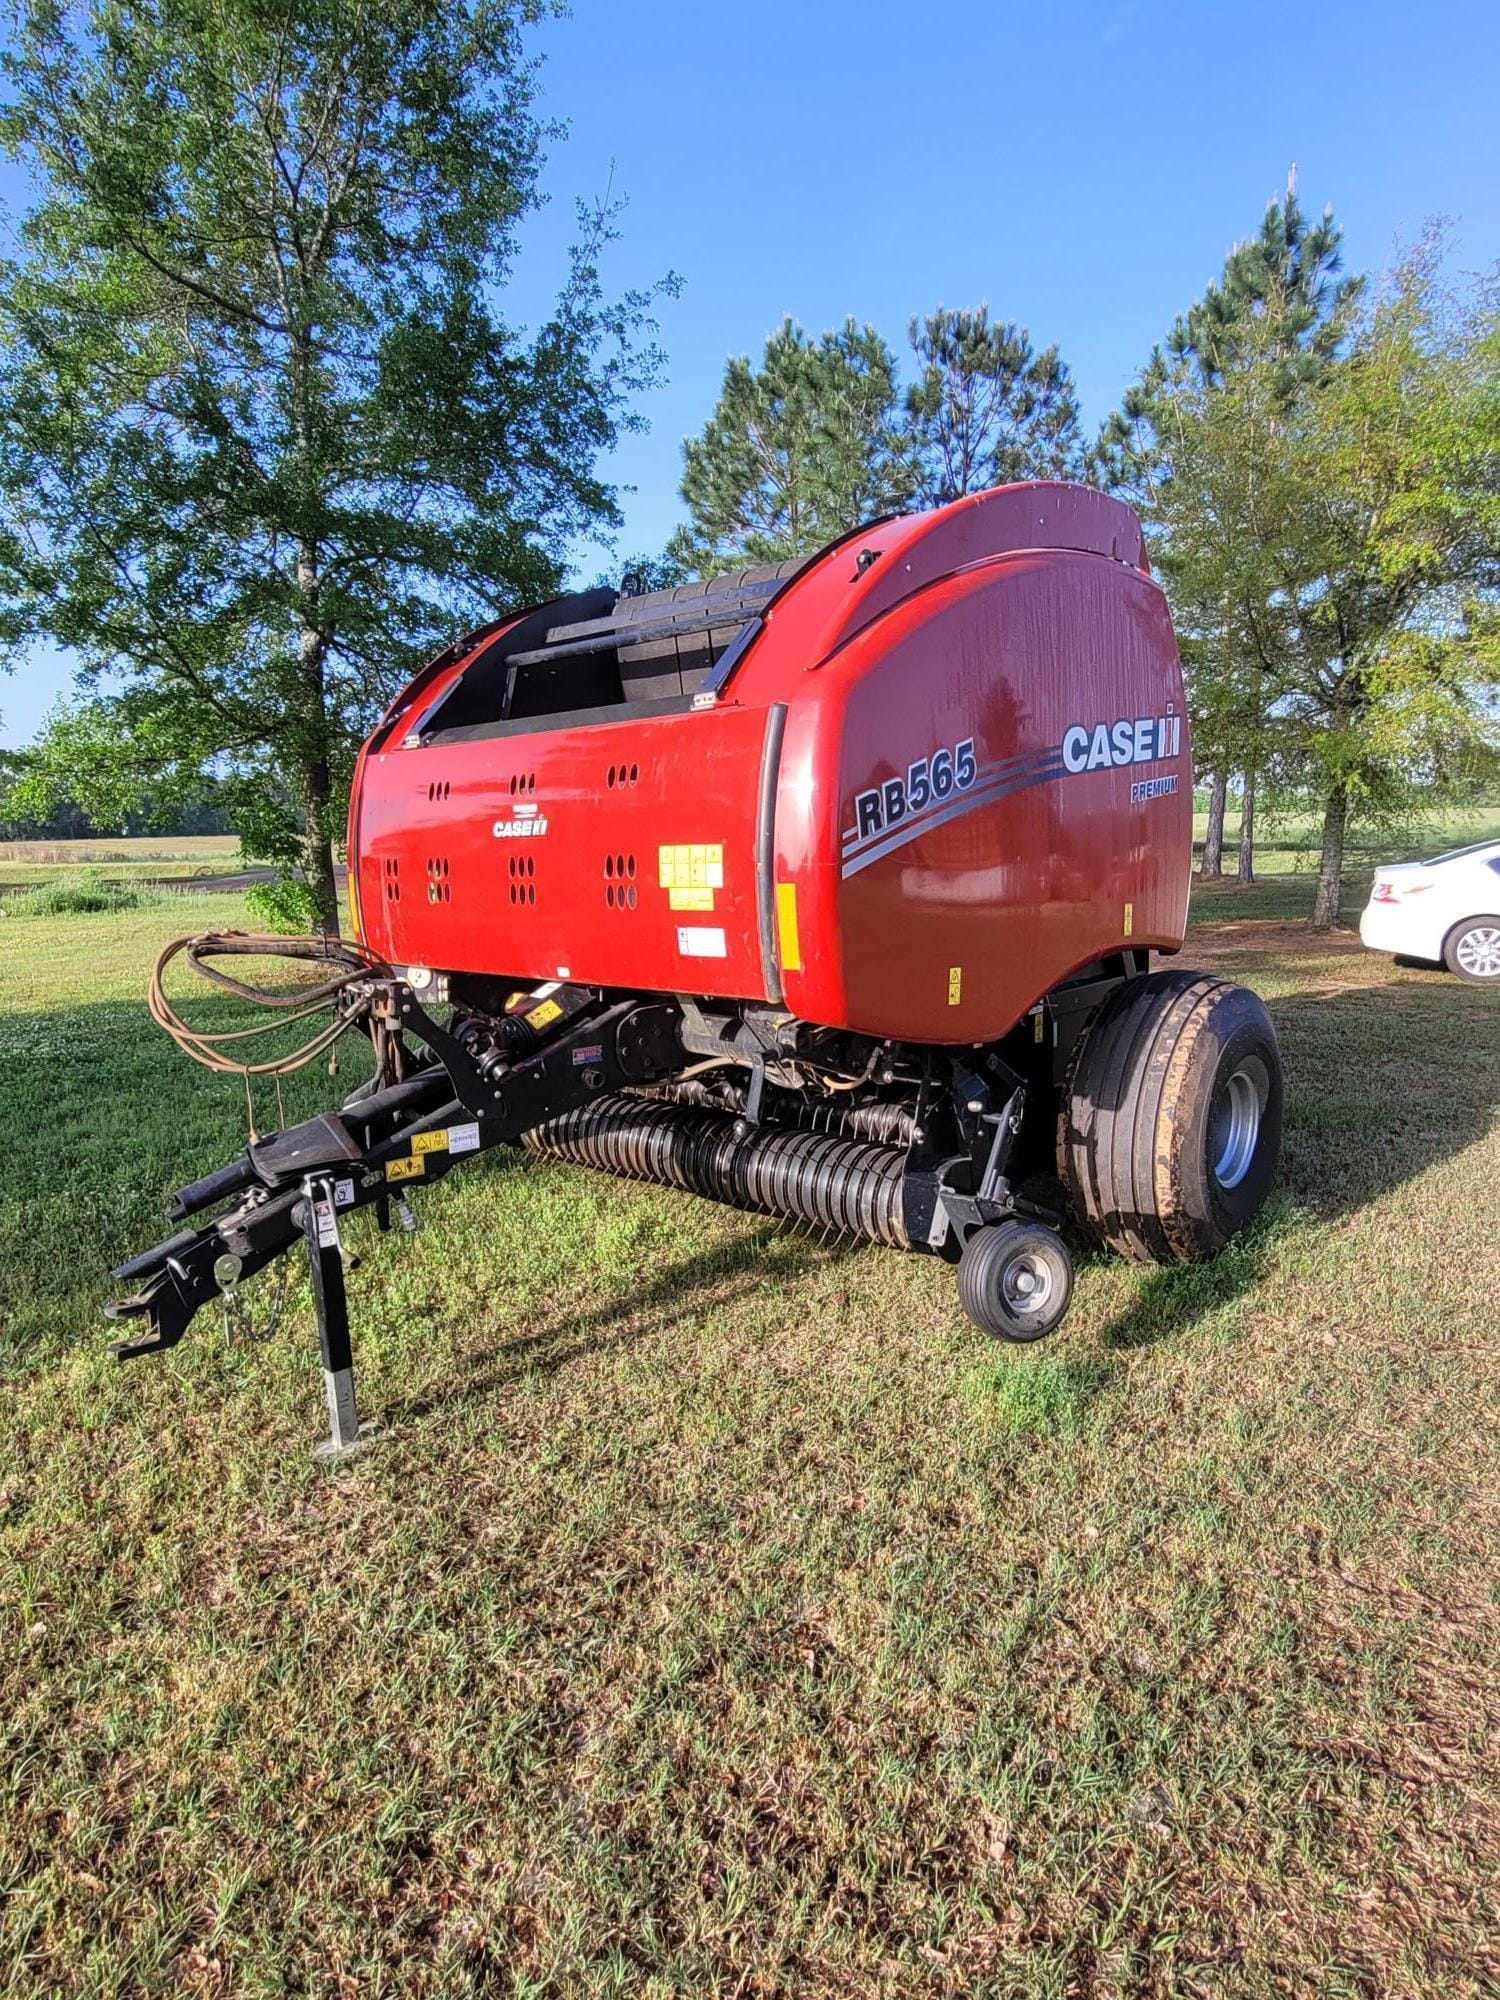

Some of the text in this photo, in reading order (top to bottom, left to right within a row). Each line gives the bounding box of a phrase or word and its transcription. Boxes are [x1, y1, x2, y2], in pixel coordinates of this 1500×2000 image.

[1062, 719, 1154, 773] CASE
[855, 736, 977, 840] RB565
[1130, 774, 1179, 803] PREMIUM
[492, 820, 533, 838] CASE
